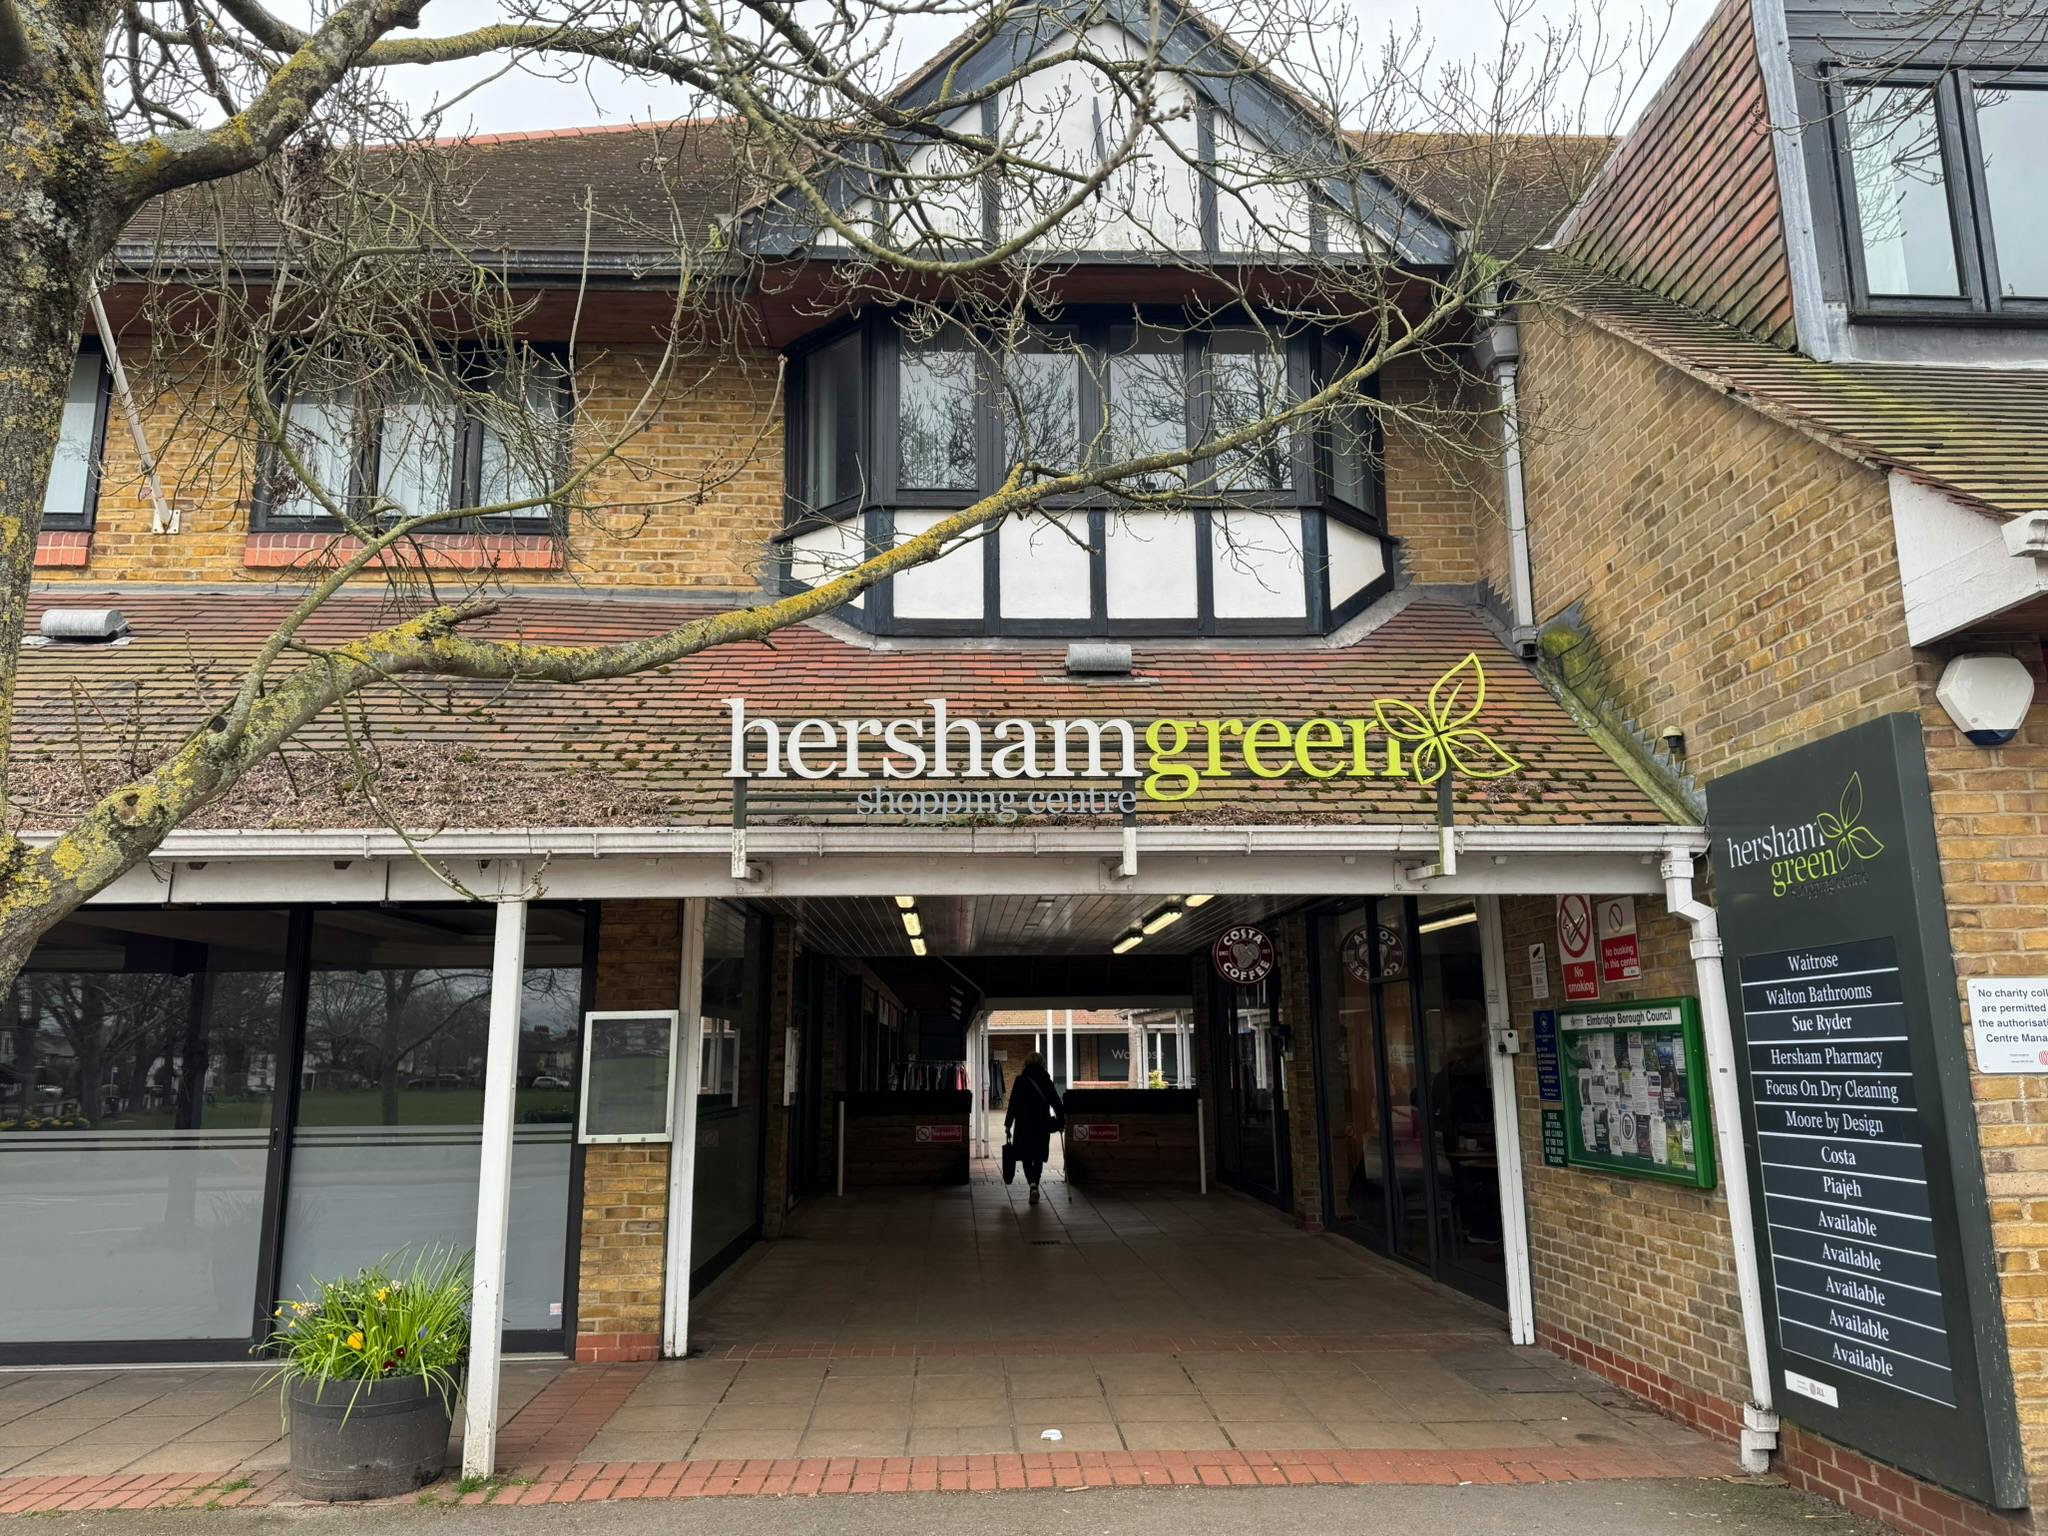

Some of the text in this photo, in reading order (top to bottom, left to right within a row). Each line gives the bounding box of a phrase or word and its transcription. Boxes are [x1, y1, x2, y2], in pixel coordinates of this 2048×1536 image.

[721, 698, 1409, 802] hersham green
[856, 786, 1137, 823] shopping centre
[1726, 821, 1827, 869] hersham
[1770, 848, 1838, 898] green
[1223, 928, 1263, 946] COSTA
[1605, 945, 1634, 957] No busking
[1787, 953, 1839, 972] Waitrose
[1223, 960, 1270, 981] COFFEE
[1574, 966, 1584, 977] No
[1568, 981, 1594, 994] smoking
[1766, 983, 1873, 1006] Walton Bathrooms
[1978, 988, 2048, 999] No charity coll
[1586, 1014, 1616, 1027] Elmbridge
[1617, 1012, 1645, 1025] Borough
[1646, 1009, 1673, 1021] Council
[2000, 1003, 2046, 1014] permitted
[1792, 1013, 1852, 1037] Sue Ryder
[1978, 1019, 1994, 1027] the
[1986, 1033, 2048, 1042] Centre Mana
[1770, 1047, 1883, 1069] Hersham Pharmacy
[1765, 1079, 1899, 1103] Focus On Dry Cleaning
[1785, 1110, 1884, 1136] Moore by Design
[1821, 1146, 1856, 1166] Costa
[1823, 1176, 1862, 1200] Piajeh
[1818, 1210, 1878, 1237] Available
[1822, 1243, 1882, 1272] Available
[1825, 1276, 1886, 1306] Available
[1829, 1309, 1890, 1342] Available
[1832, 1343, 1894, 1377] Available
